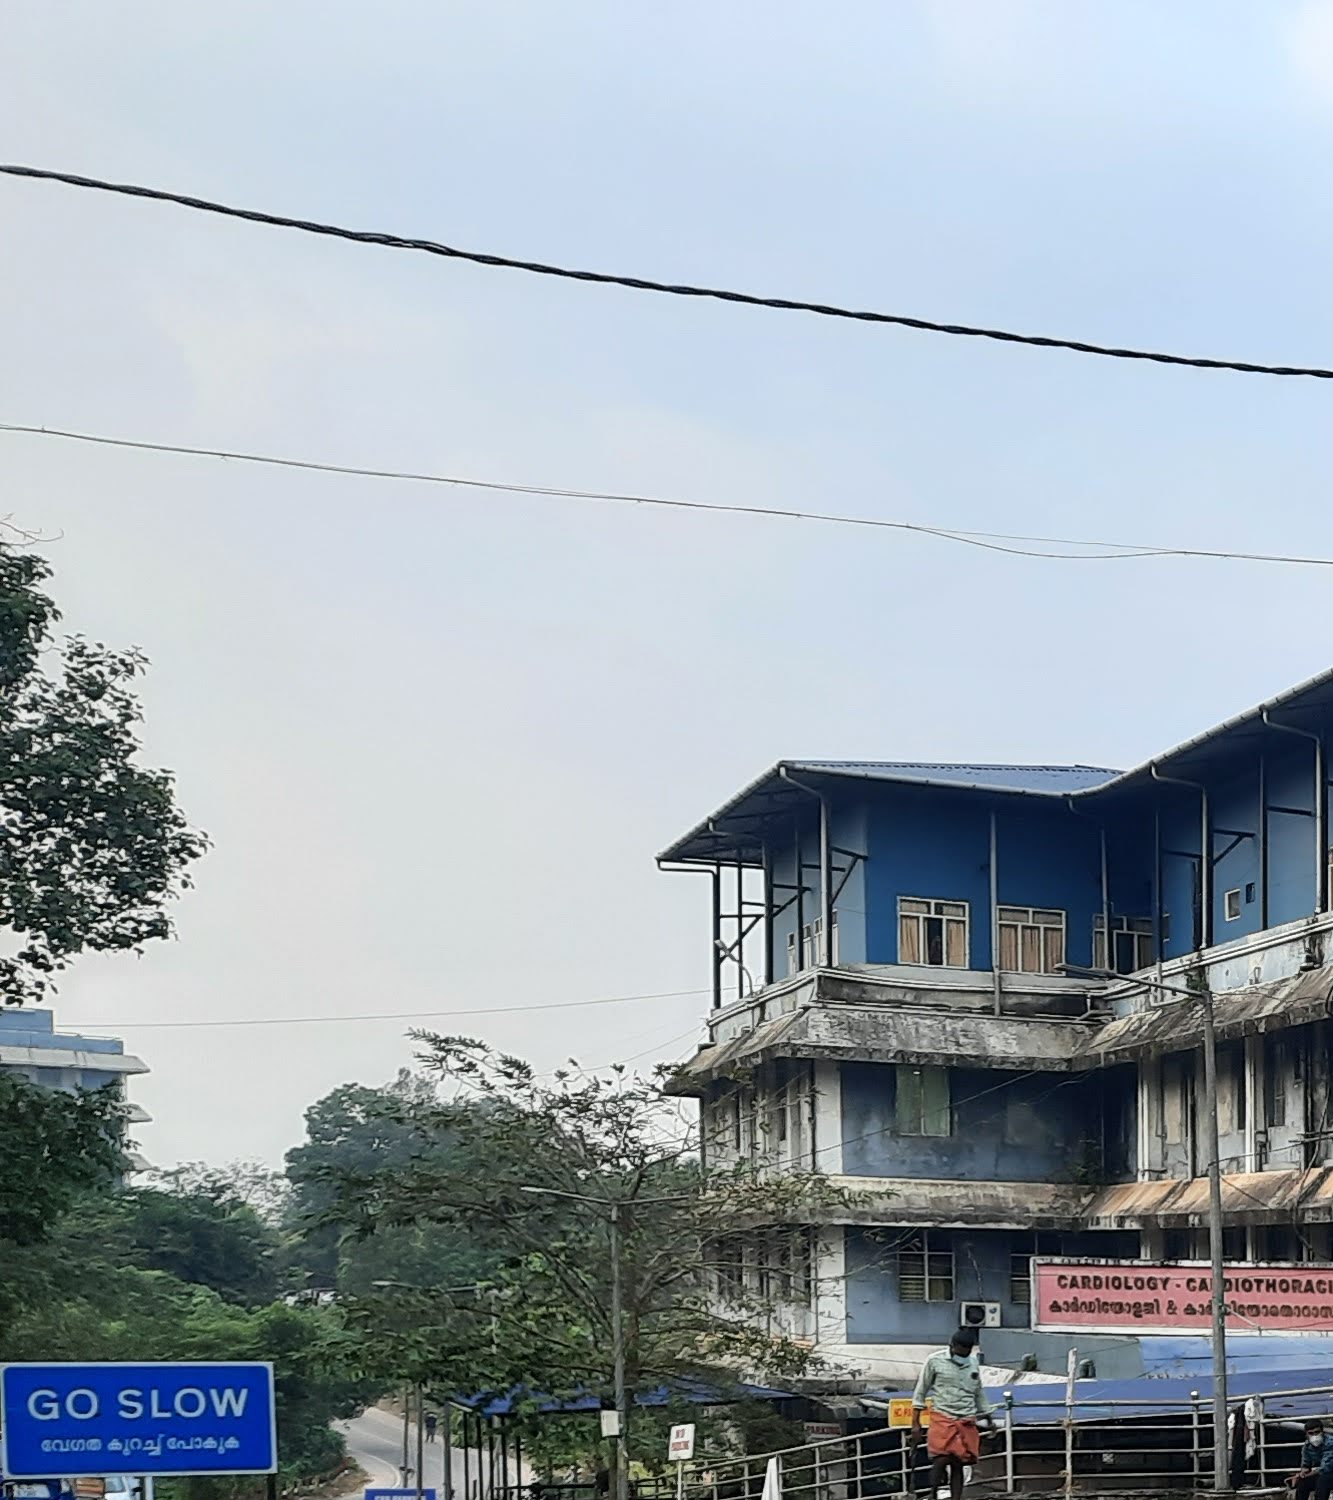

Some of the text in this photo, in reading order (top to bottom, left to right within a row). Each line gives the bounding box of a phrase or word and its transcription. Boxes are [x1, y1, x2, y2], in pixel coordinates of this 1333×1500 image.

[1057, 1274, 1171, 1291] CARDIOLOGY
[1166, 1300, 1178, 1315] &
[27, 1387, 249, 1421] GO SLOW
[41, 1437, 103, 1453] വേഗത
[166, 1435, 240, 1455] പോകുക
